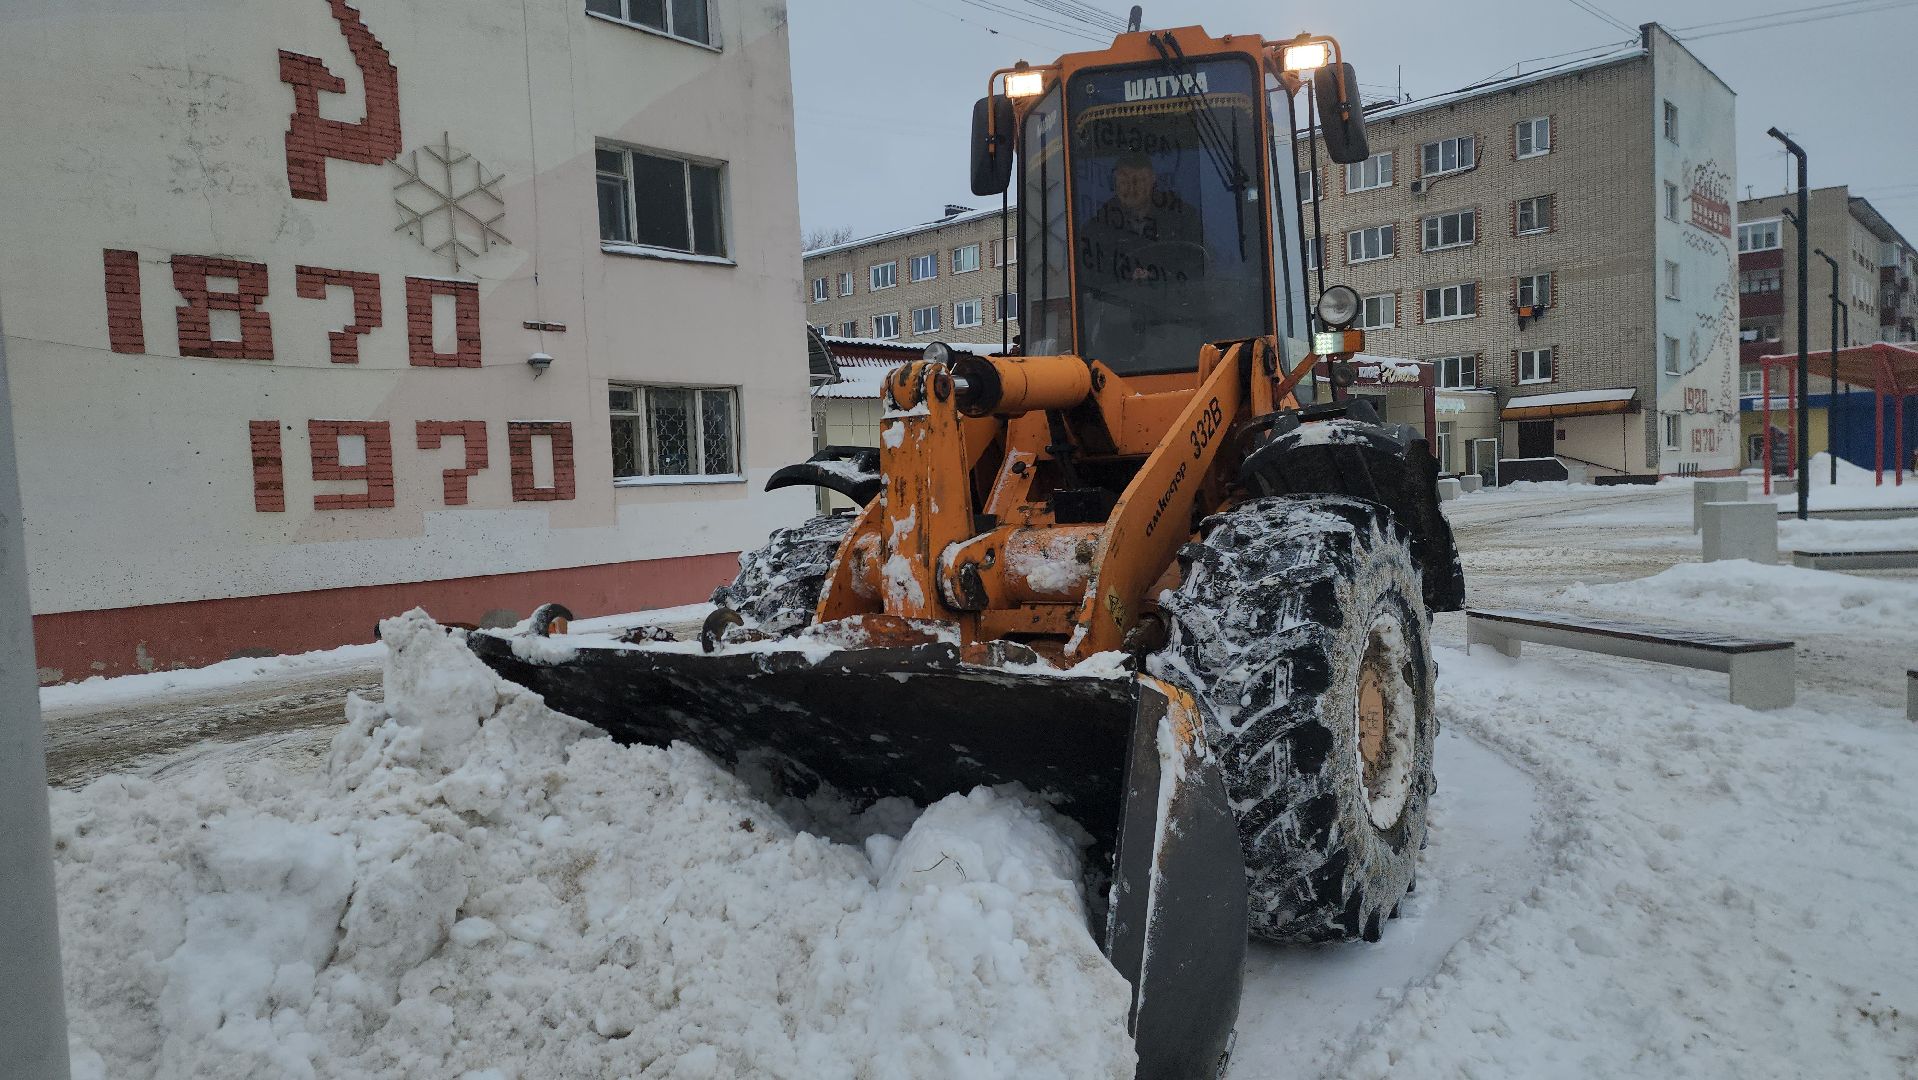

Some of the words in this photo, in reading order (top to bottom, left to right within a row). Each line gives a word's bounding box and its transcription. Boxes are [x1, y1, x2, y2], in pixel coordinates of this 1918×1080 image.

[1124, 72, 1208, 101] ШАТУРА
[103, 248, 482, 367] 1870
[249, 419, 576, 512] 1970
